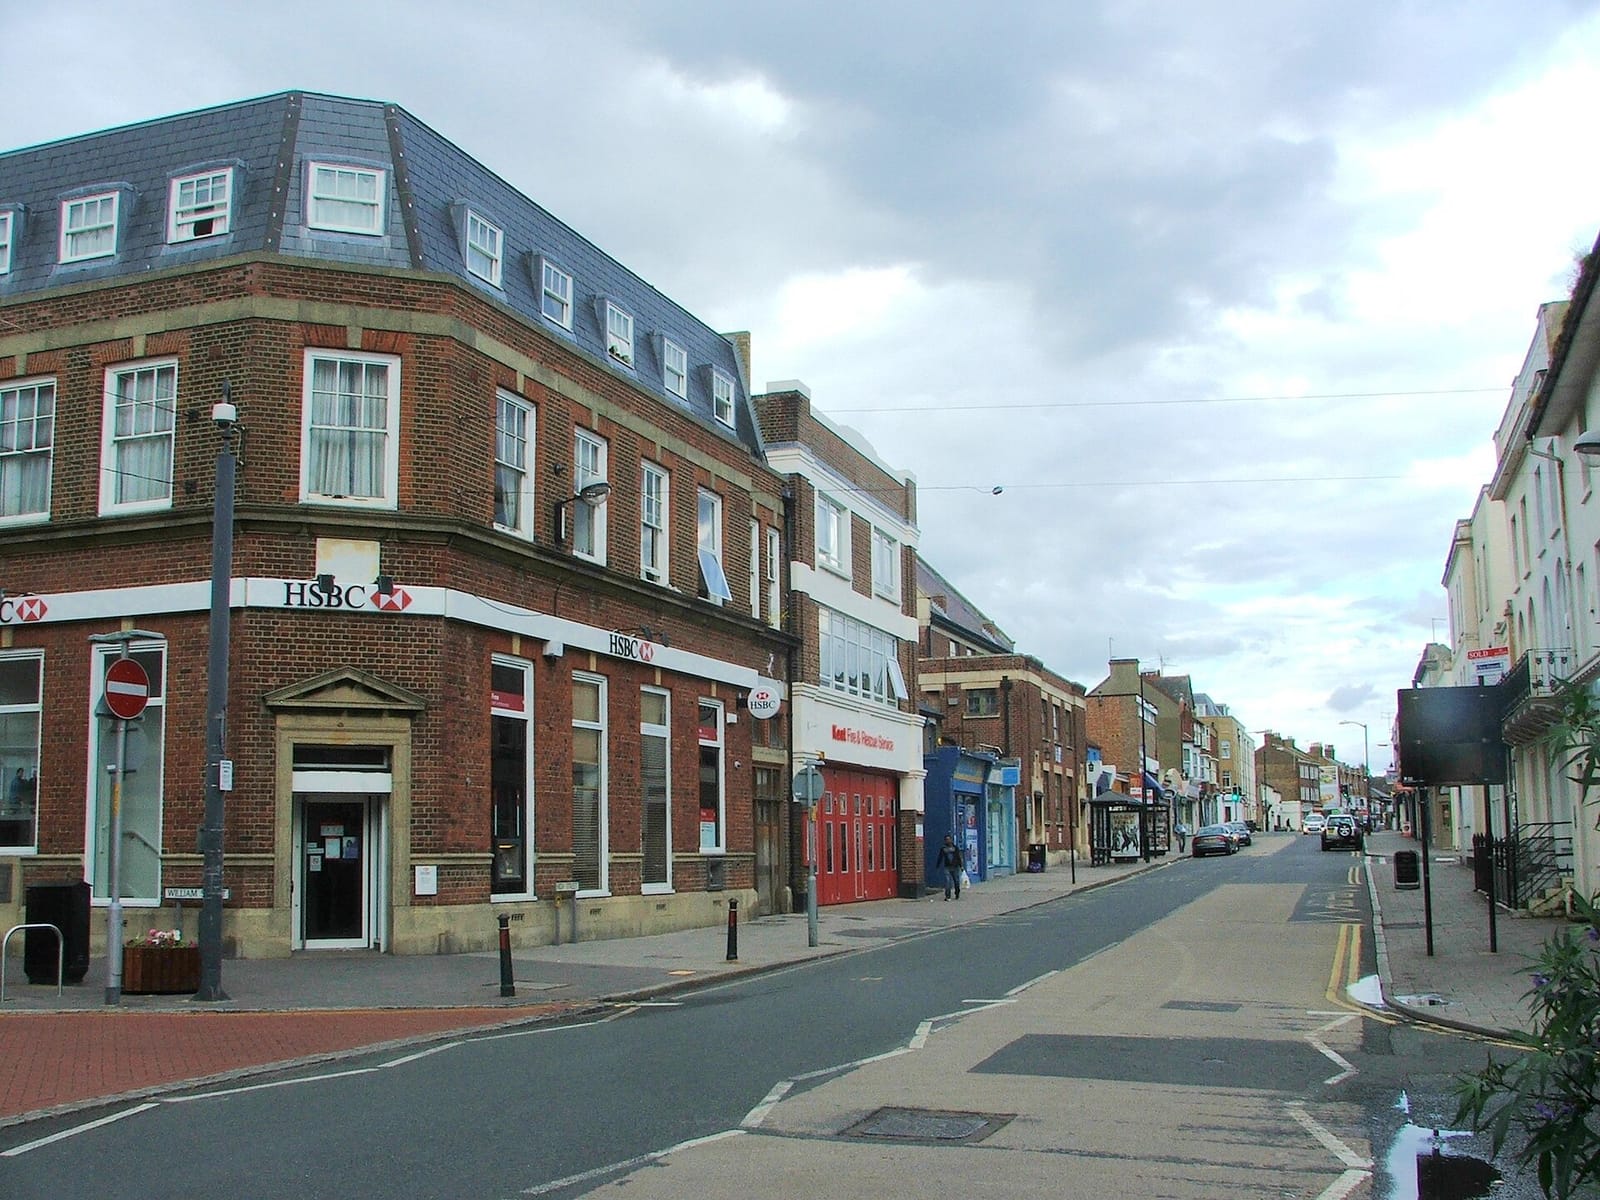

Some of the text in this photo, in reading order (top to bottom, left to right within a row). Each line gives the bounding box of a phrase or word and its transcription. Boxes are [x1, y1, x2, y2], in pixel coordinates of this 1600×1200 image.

[283, 582, 366, 609] HSBC
[609, 633, 639, 659] HSBC
[1469, 650, 1489, 658] SOLD
[750, 700, 776, 710] HSBC
[832, 724, 846, 741] Kent
[847, 728, 856, 744] Fire
[168, 888, 198, 898] WILLIAM
